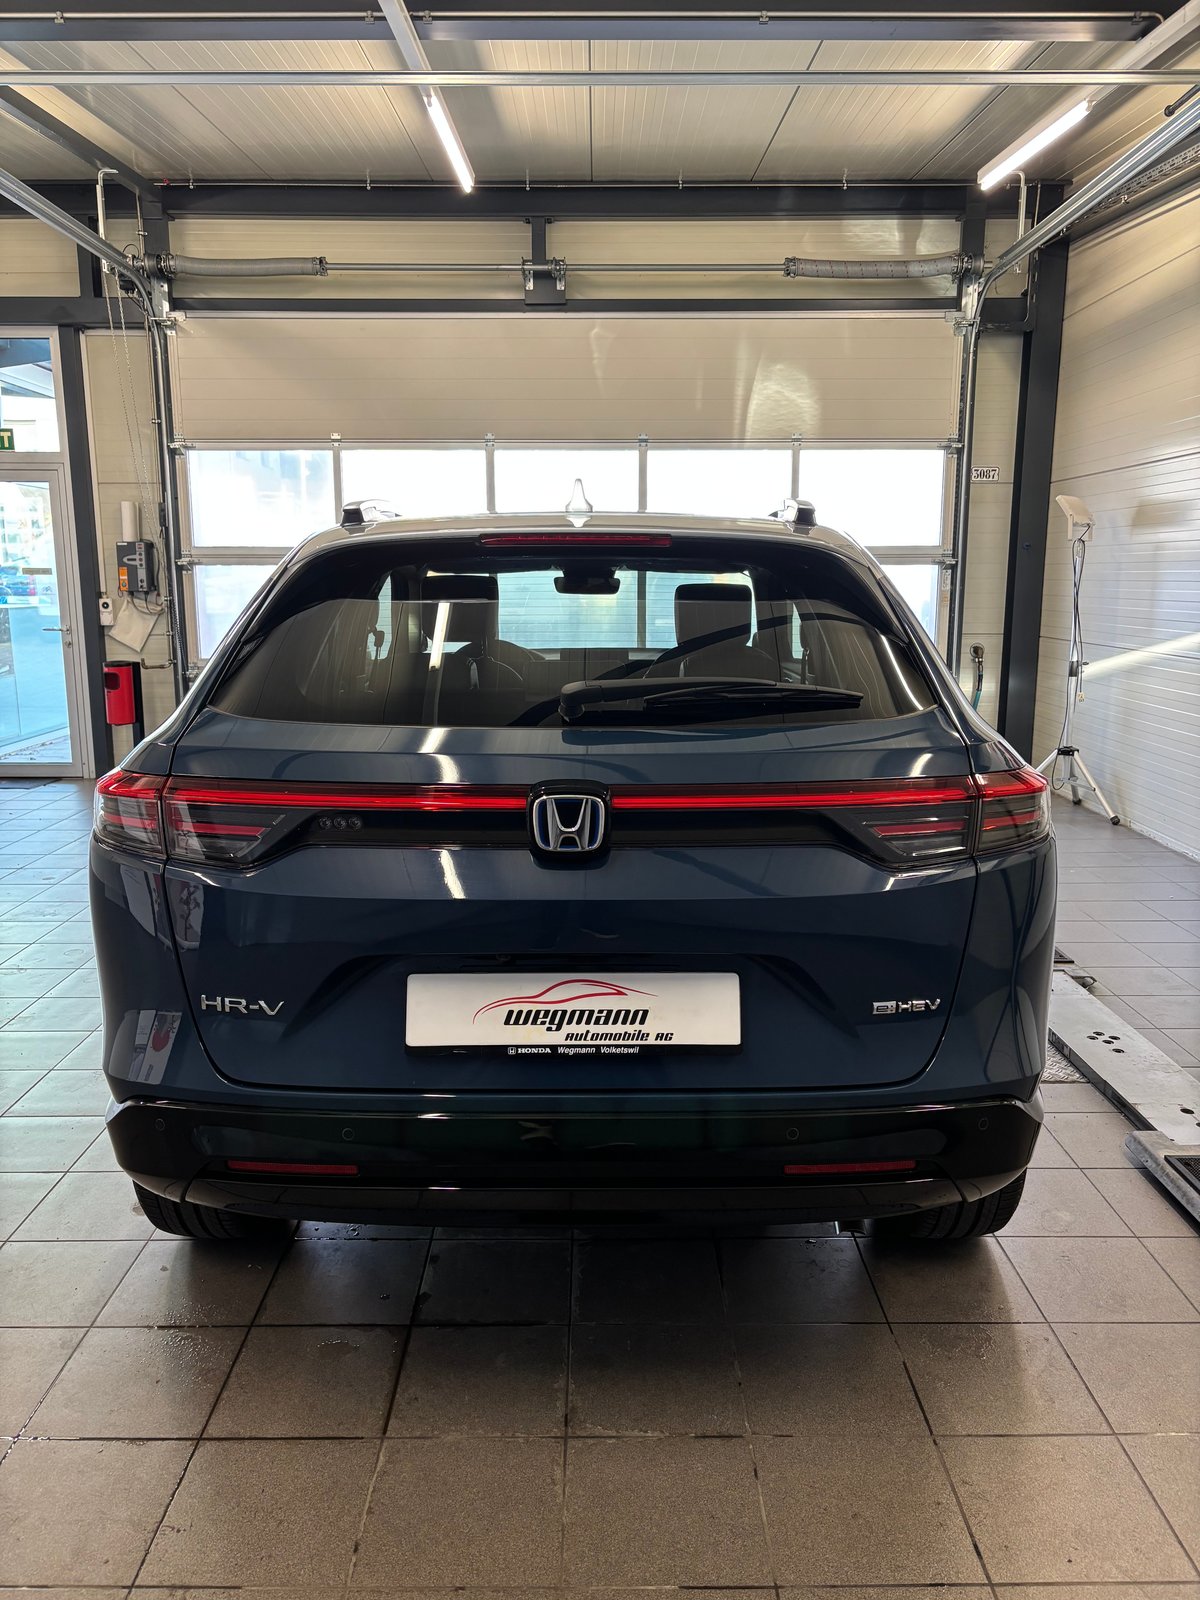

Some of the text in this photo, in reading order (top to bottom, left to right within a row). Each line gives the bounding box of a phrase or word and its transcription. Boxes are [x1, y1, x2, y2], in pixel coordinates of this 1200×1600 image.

[973, 469, 997, 480] 3087
[201, 994, 285, 1016] HR-V
[504, 1009, 649, 1031] wegmann
[557, 1047, 596, 1055] Wegmann
[600, 1046, 640, 1054] Volketswil
